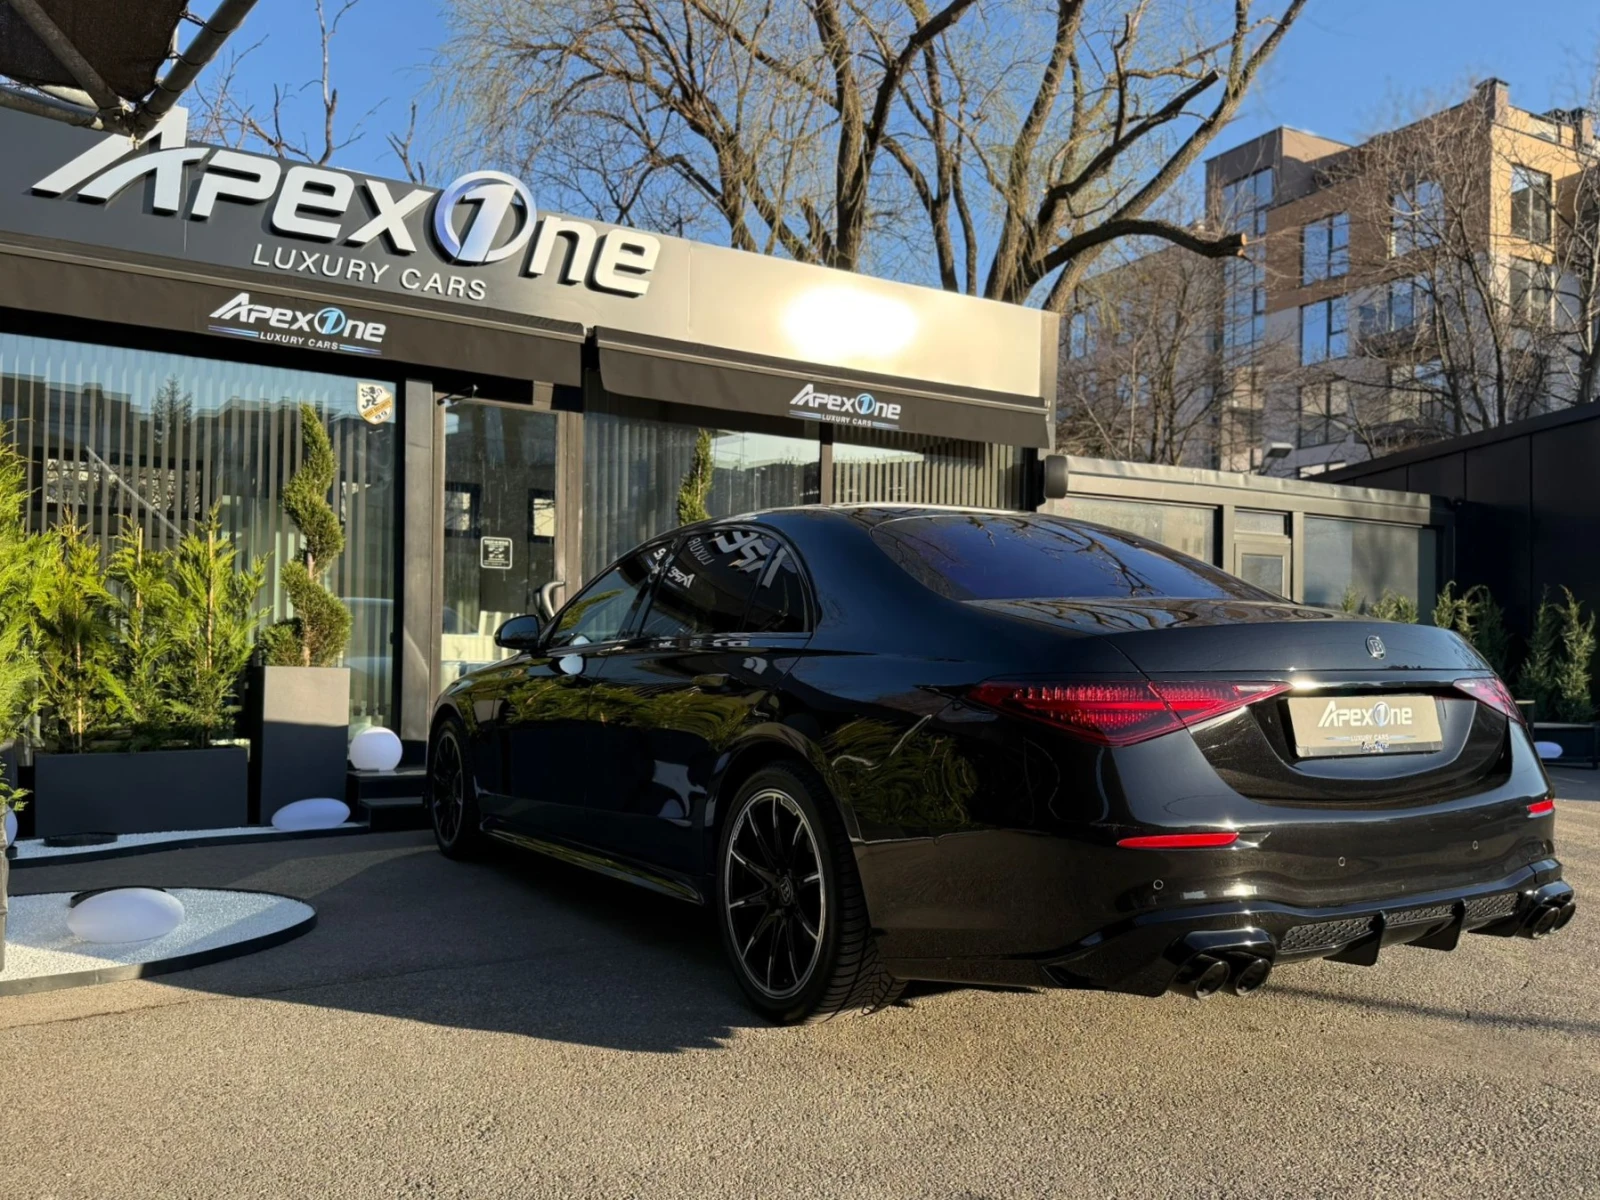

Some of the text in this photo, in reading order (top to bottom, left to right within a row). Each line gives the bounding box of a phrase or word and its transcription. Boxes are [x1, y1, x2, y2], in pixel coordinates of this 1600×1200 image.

[252, 243, 487, 301] LUXURY CARS
[259, 331, 339, 350] LUXURY CARS
[821, 414, 872, 427] LUXURY CARS
[1373, 733, 1390, 741] CARS
